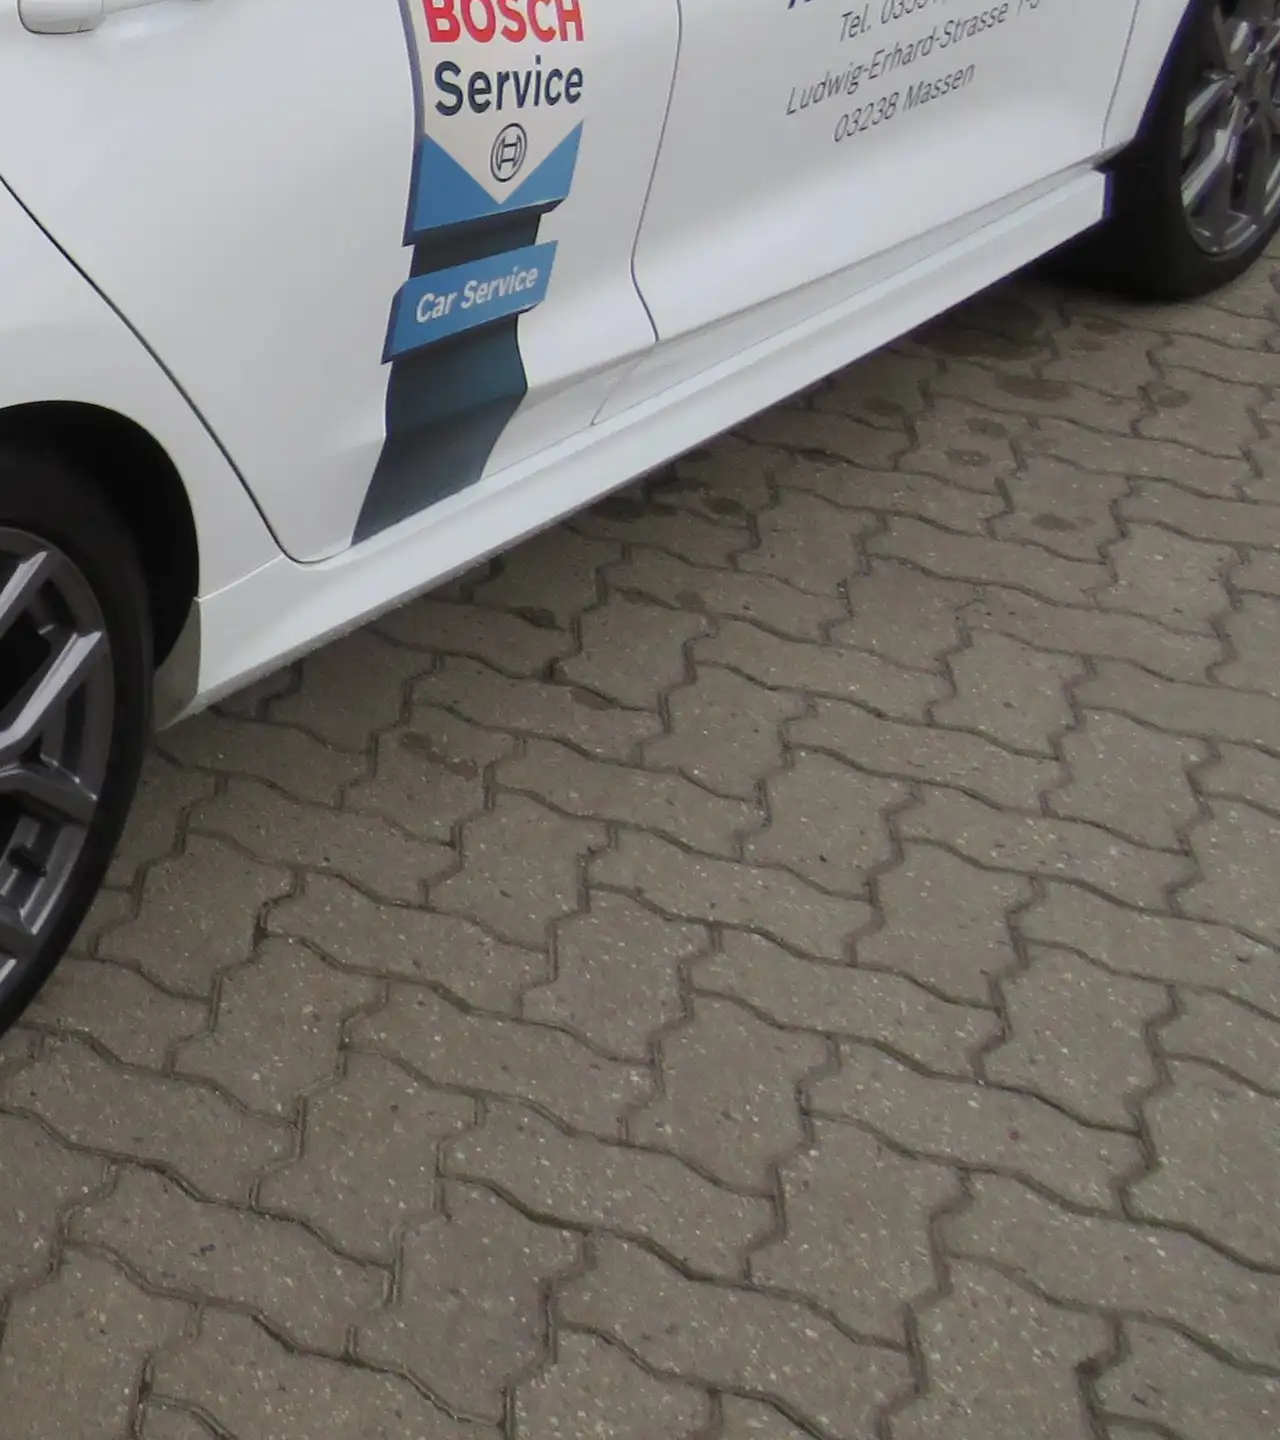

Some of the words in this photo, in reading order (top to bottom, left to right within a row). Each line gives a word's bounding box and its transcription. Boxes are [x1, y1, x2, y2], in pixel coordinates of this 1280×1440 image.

[840, 3, 871, 42] Tel.
[434, 54, 584, 117] Service
[786, 2, 1009, 116] Ludwig-Erhard-Strasse
[834, 91, 899, 143] 03238
[902, 63, 976, 112] Massen
[416, 291, 457, 324] Car
[460, 266, 539, 309] Service
